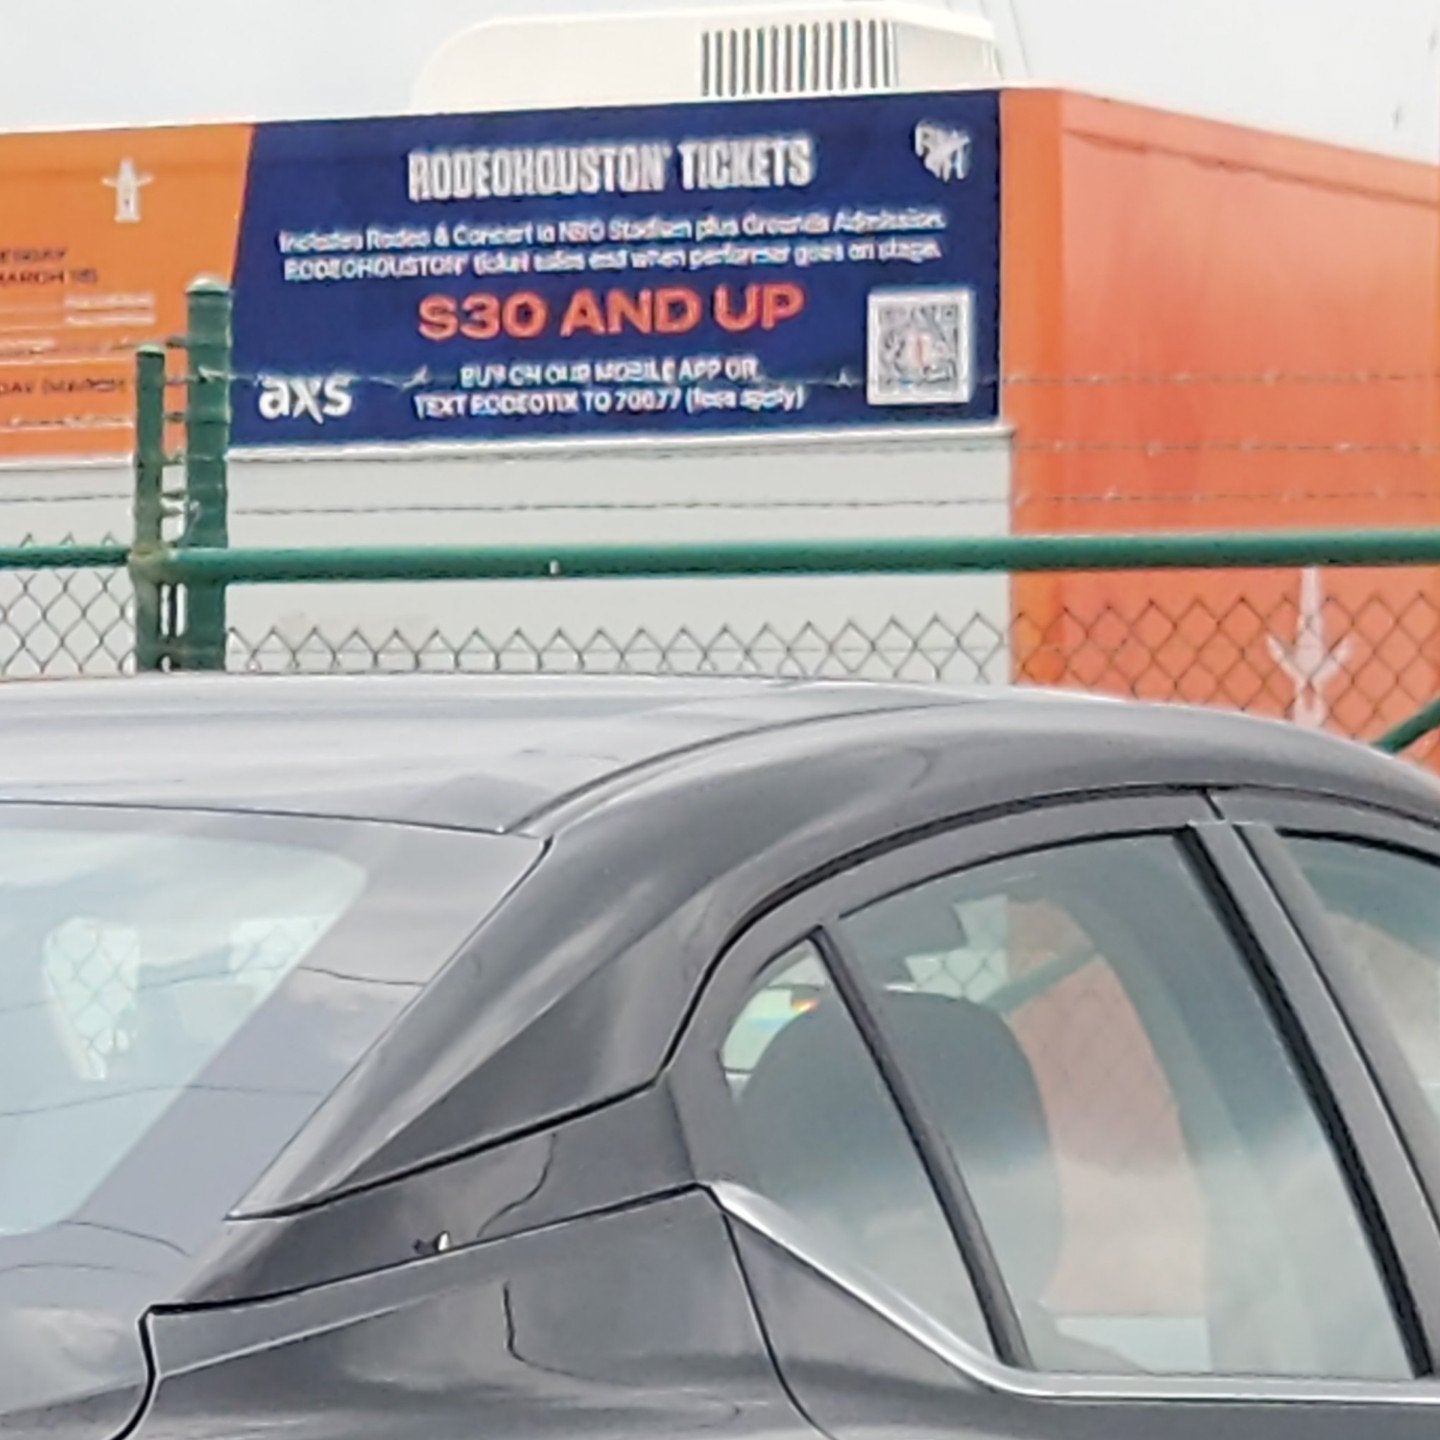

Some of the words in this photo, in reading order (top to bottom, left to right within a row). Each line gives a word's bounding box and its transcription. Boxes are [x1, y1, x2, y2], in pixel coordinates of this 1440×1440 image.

[676, 136, 814, 190] TICKETS
[561, 287, 703, 338] AND
[713, 283, 806, 331] UP
[584, 389, 611, 413] TO
